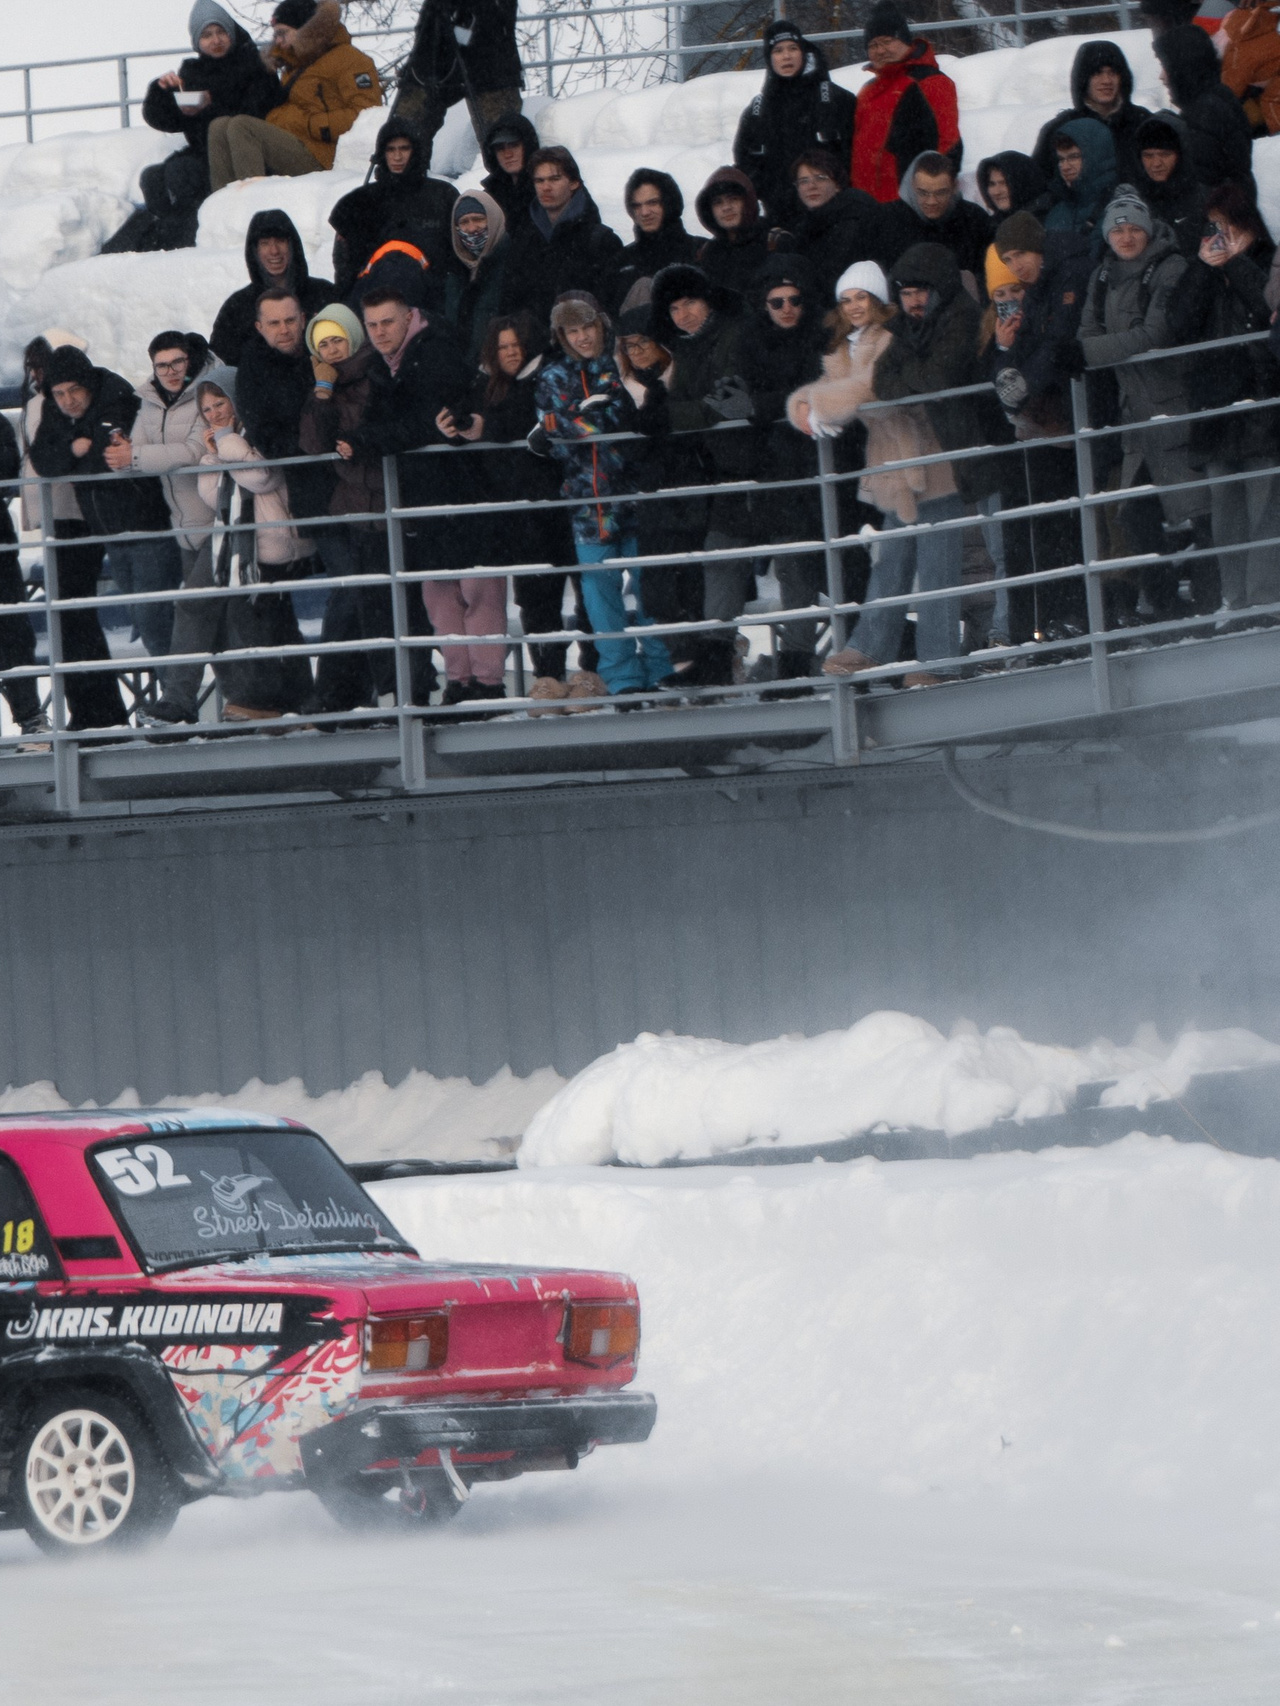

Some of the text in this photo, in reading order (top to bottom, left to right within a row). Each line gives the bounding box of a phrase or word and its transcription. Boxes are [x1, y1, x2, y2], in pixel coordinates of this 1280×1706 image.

[94, 1144, 191, 1196] 52
[3, 1218, 35, 1254] 18
[193, 1197, 380, 1238] Street Detailing
[35, 1302, 283, 1339] KRIS.KUDINOVA
